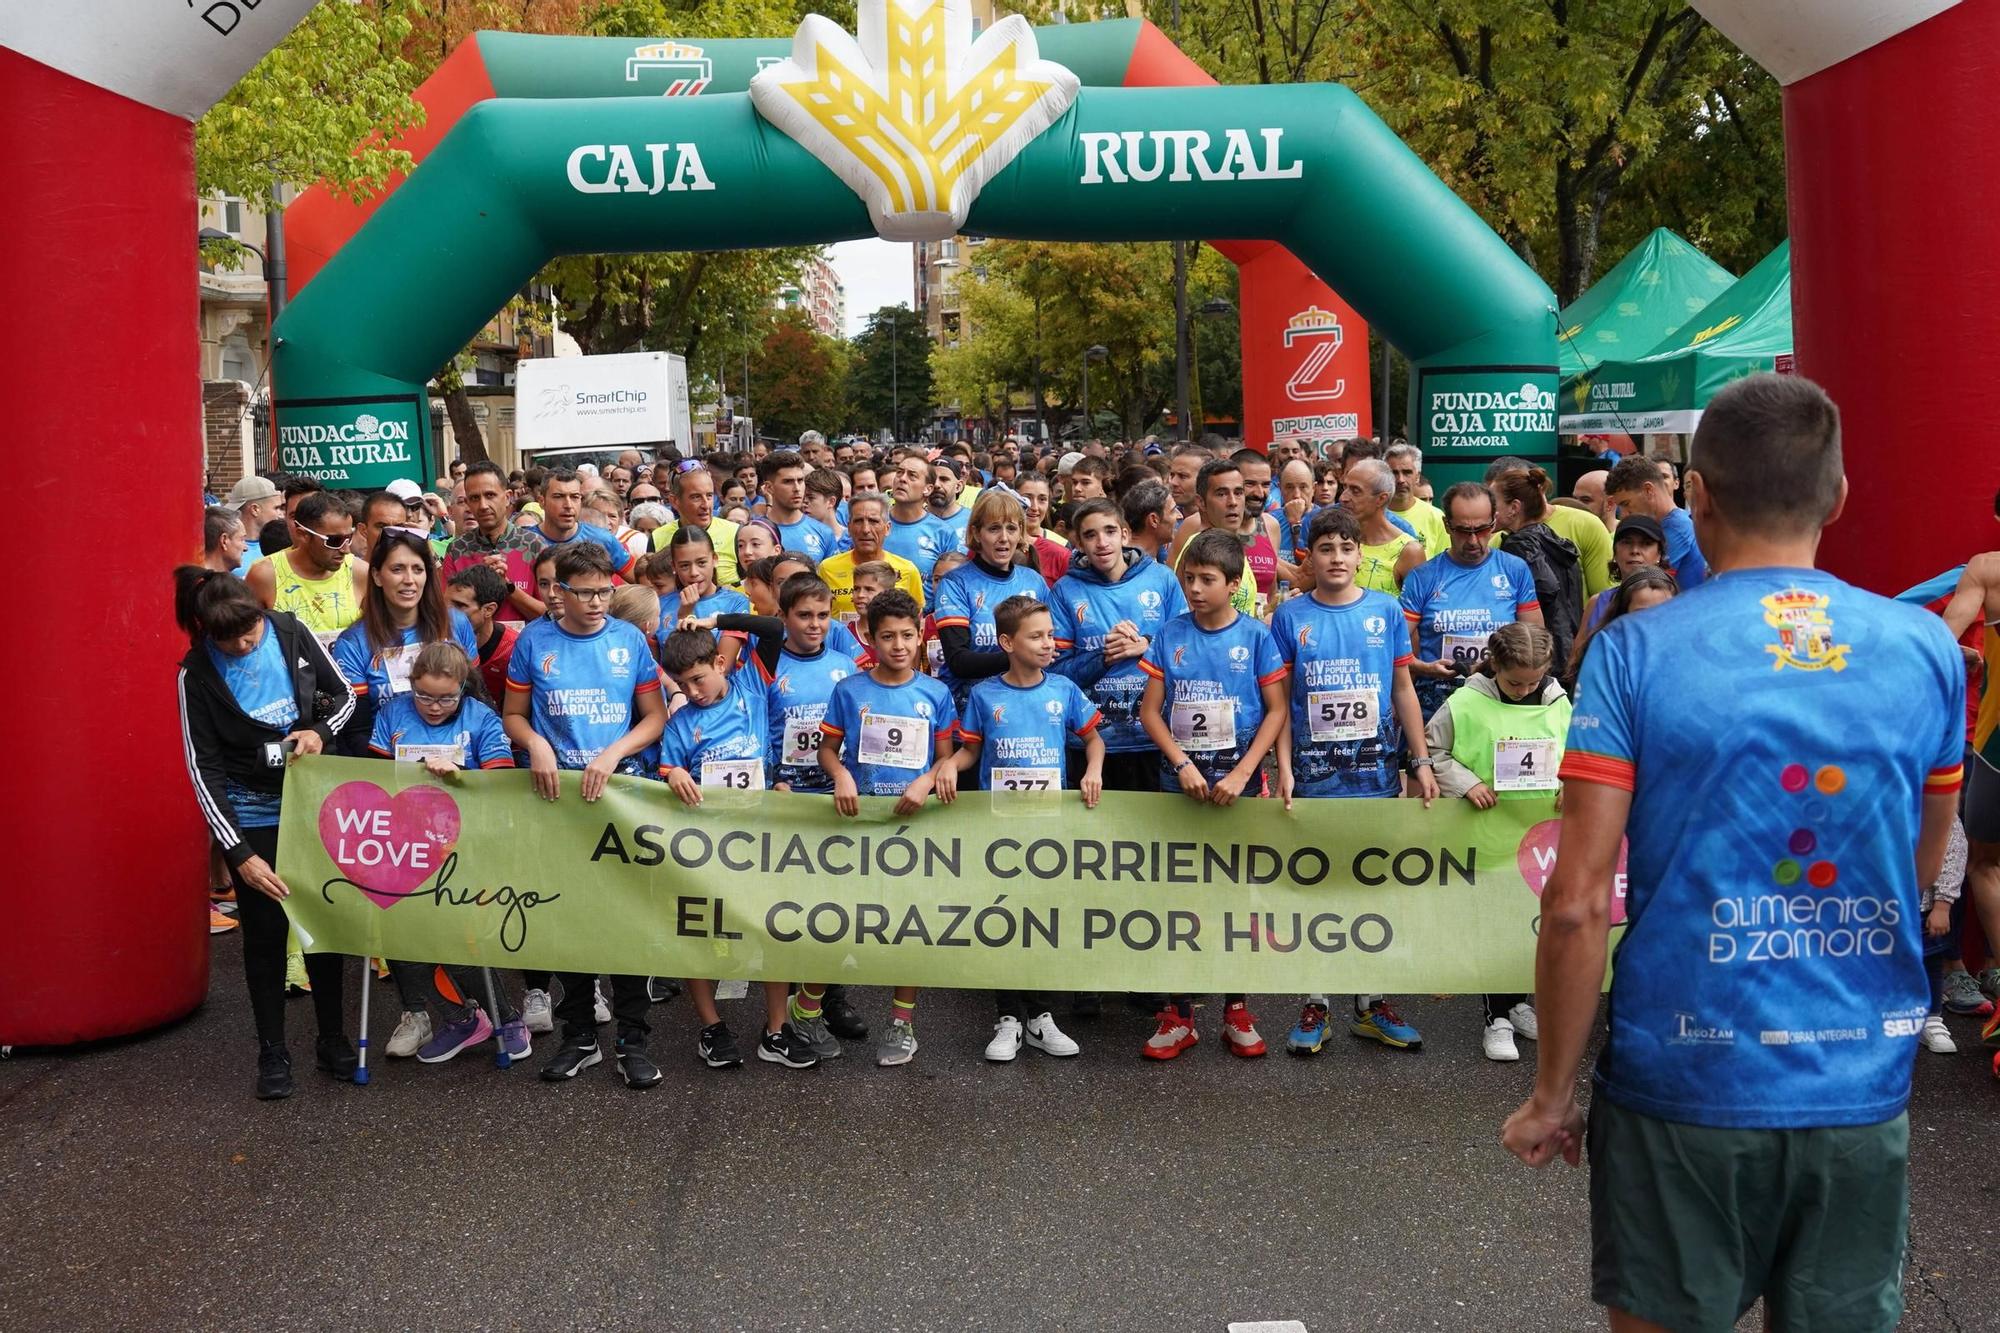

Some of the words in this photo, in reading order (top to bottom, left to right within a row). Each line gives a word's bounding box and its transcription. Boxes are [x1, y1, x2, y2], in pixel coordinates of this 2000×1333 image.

[201, 0, 260, 36] D
[567, 143, 716, 195] CAJA
[1079, 128, 1303, 184] RURAL
[576, 390, 647, 404] SmartChip
[1592, 383, 1609, 399] CAJA
[1611, 382, 1636, 398] RURAL
[577, 406, 647, 416] www.smartchip.es
[1431, 413, 1486, 434] CAJA
[1493, 413, 1556, 432] RURAL
[1432, 437, 1447, 447] DE
[1451, 436, 1509, 447] ZAMORA
[283, 446, 324, 468] CAJA
[330, 442, 411, 466] RURAL
[1434, 610, 1457, 623] XIV
[1434, 621, 1484, 632] GUARDIA
[1303, 661, 1325, 677] XIV
[1325, 666, 1360, 674] POPULAR
[1174, 679, 1192, 693] XIV
[1192, 680, 1223, 688] CARRERA
[1306, 674, 1352, 686] GUARDIA
[1355, 673, 1381, 684] CIVIL
[546, 689, 569, 704] XIV
[569, 688, 606, 696] CARRERA
[569, 696, 607, 704] POPULAR
[549, 704, 599, 716] GUARDIA
[602, 703, 627, 714] CIVIL
[783, 706, 804, 719] XIV
[1109, 700, 1132, 709] feder
[1321, 701, 1368, 721] 578
[1192, 713, 1207, 731] 2
[797, 731, 821, 751] 93
[887, 728, 903, 746] 9
[996, 738, 1016, 750] XIV
[566, 749, 601, 757] FUNDAC
[997, 749, 1039, 759] GUARDIA
[1041, 748, 1060, 758] CIVIL
[1334, 747, 1356, 756] feder
[1520, 752, 1534, 770] 4
[723, 772, 750, 789] 13
[336, 808, 392, 836] WE
[338, 838, 430, 868] LOVE
[590, 822, 961, 878] ASOCIACIÓN
[984, 838, 1330, 886] CORRIENDO
[1352, 847, 1477, 887] CON
[380, 852, 561, 952] hugo
[676, 896, 743, 940] EL
[765, 895, 1060, 949] CORAZÓN
[1083, 908, 1202, 952] POR
[1224, 912, 1393, 954] HUGO
[1746, 928, 1895, 961] zamora
[1789, 1031, 1815, 1043] OBRAS
[1817, 1028, 1867, 1042] INTEGRALES
[1883, 1018, 1925, 1037] SEU
